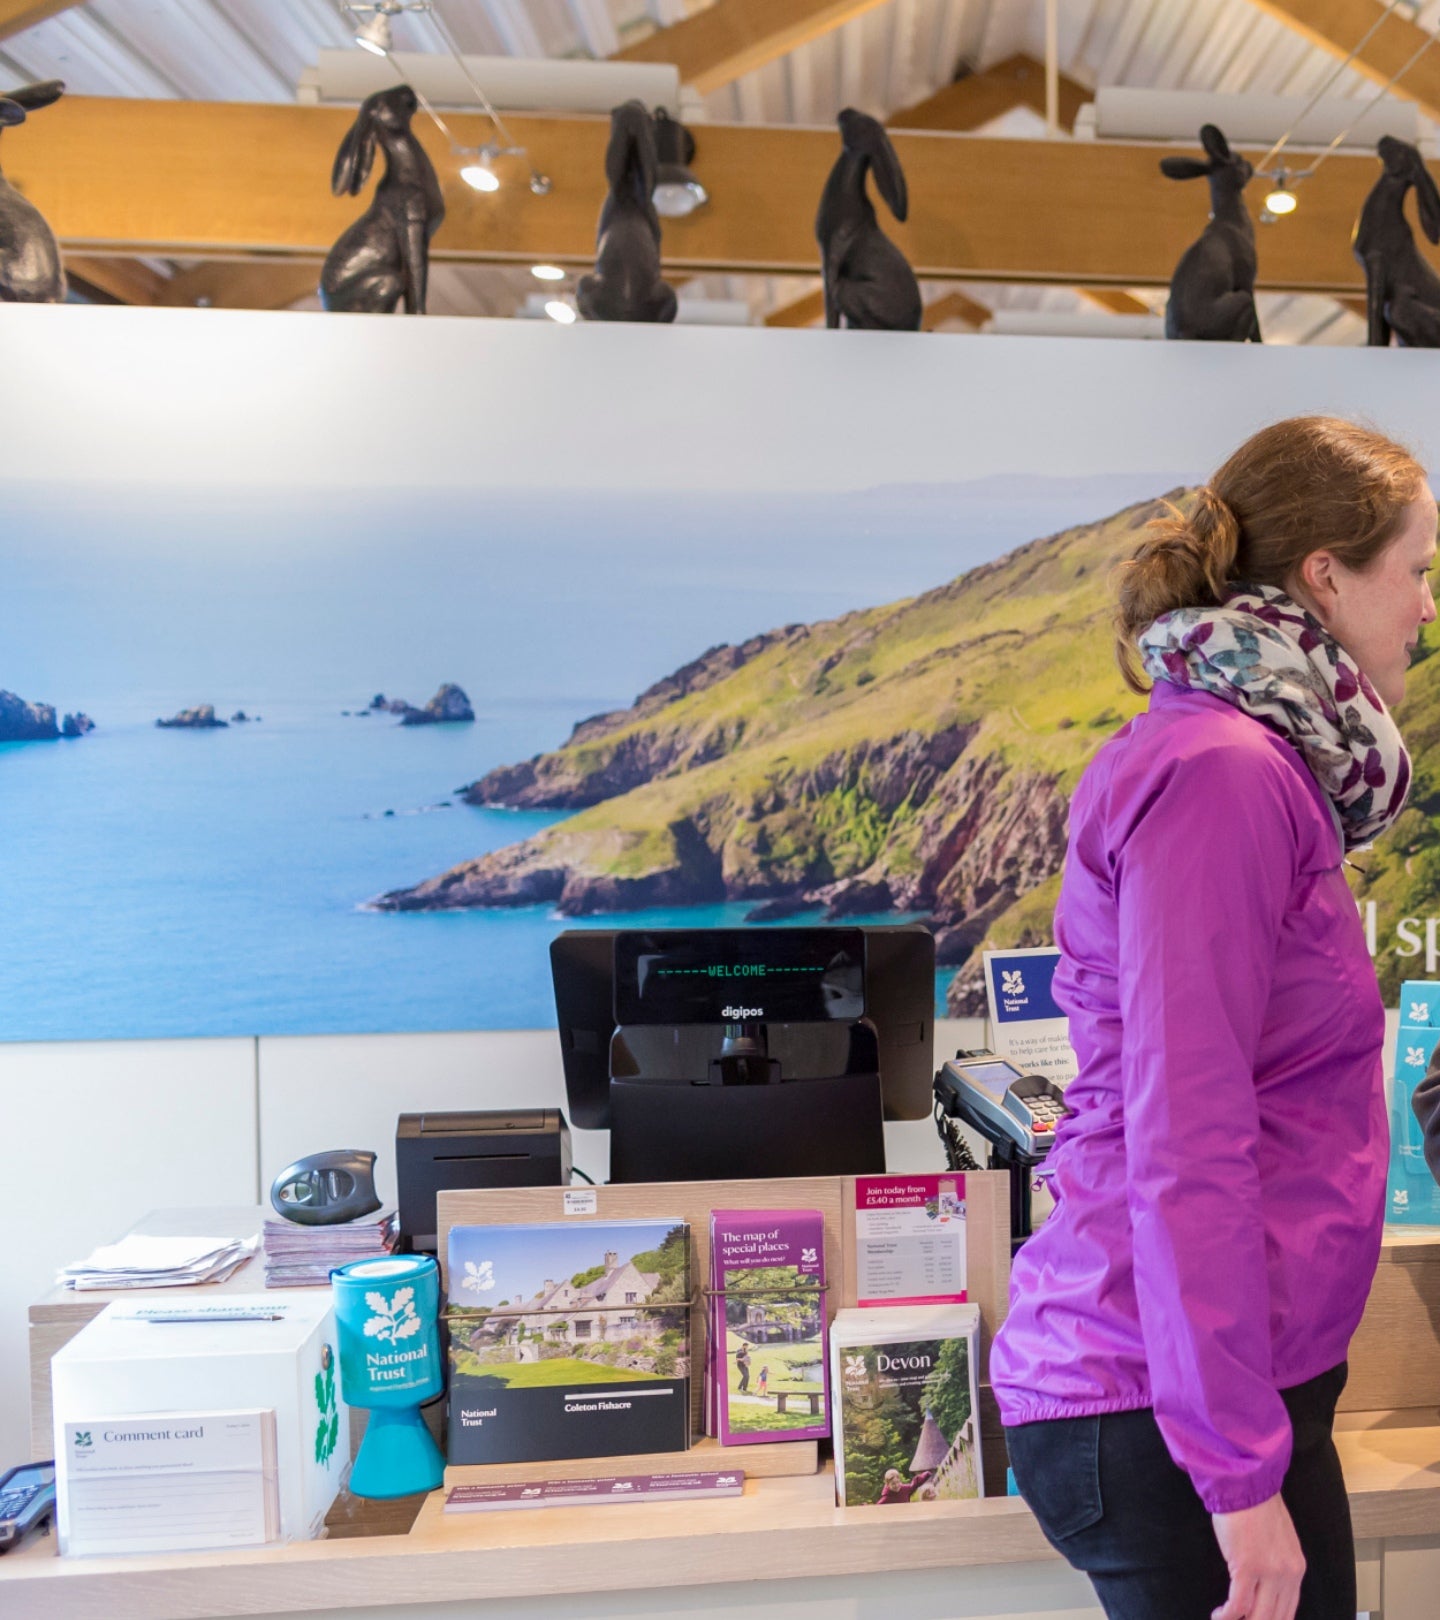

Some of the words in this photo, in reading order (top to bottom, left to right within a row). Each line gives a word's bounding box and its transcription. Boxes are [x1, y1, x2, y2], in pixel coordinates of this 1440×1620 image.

[1003, 997, 1029, 1005] National
[721, 1006, 764, 1019] digipos
[866, 1187, 883, 1196] Join
[884, 1186, 906, 1196] today
[907, 1185, 926, 1194] from
[895, 1195, 921, 1203] month
[722, 1232, 741, 1243] The
[743, 1233, 766, 1242] map
[767, 1229, 780, 1239] of
[722, 1242, 757, 1256] special
[758, 1242, 790, 1254] places
[366, 1343, 428, 1366] National
[877, 1354, 931, 1372] Devon
[367, 1366, 406, 1381] Trust
[461, 1408, 497, 1418] National
[564, 1403, 597, 1413] Coleton
[598, 1401, 632, 1411] Fishacre
[461, 1418, 482, 1427] Trust
[103, 1428, 171, 1444] Comment
[174, 1426, 204, 1439] card
